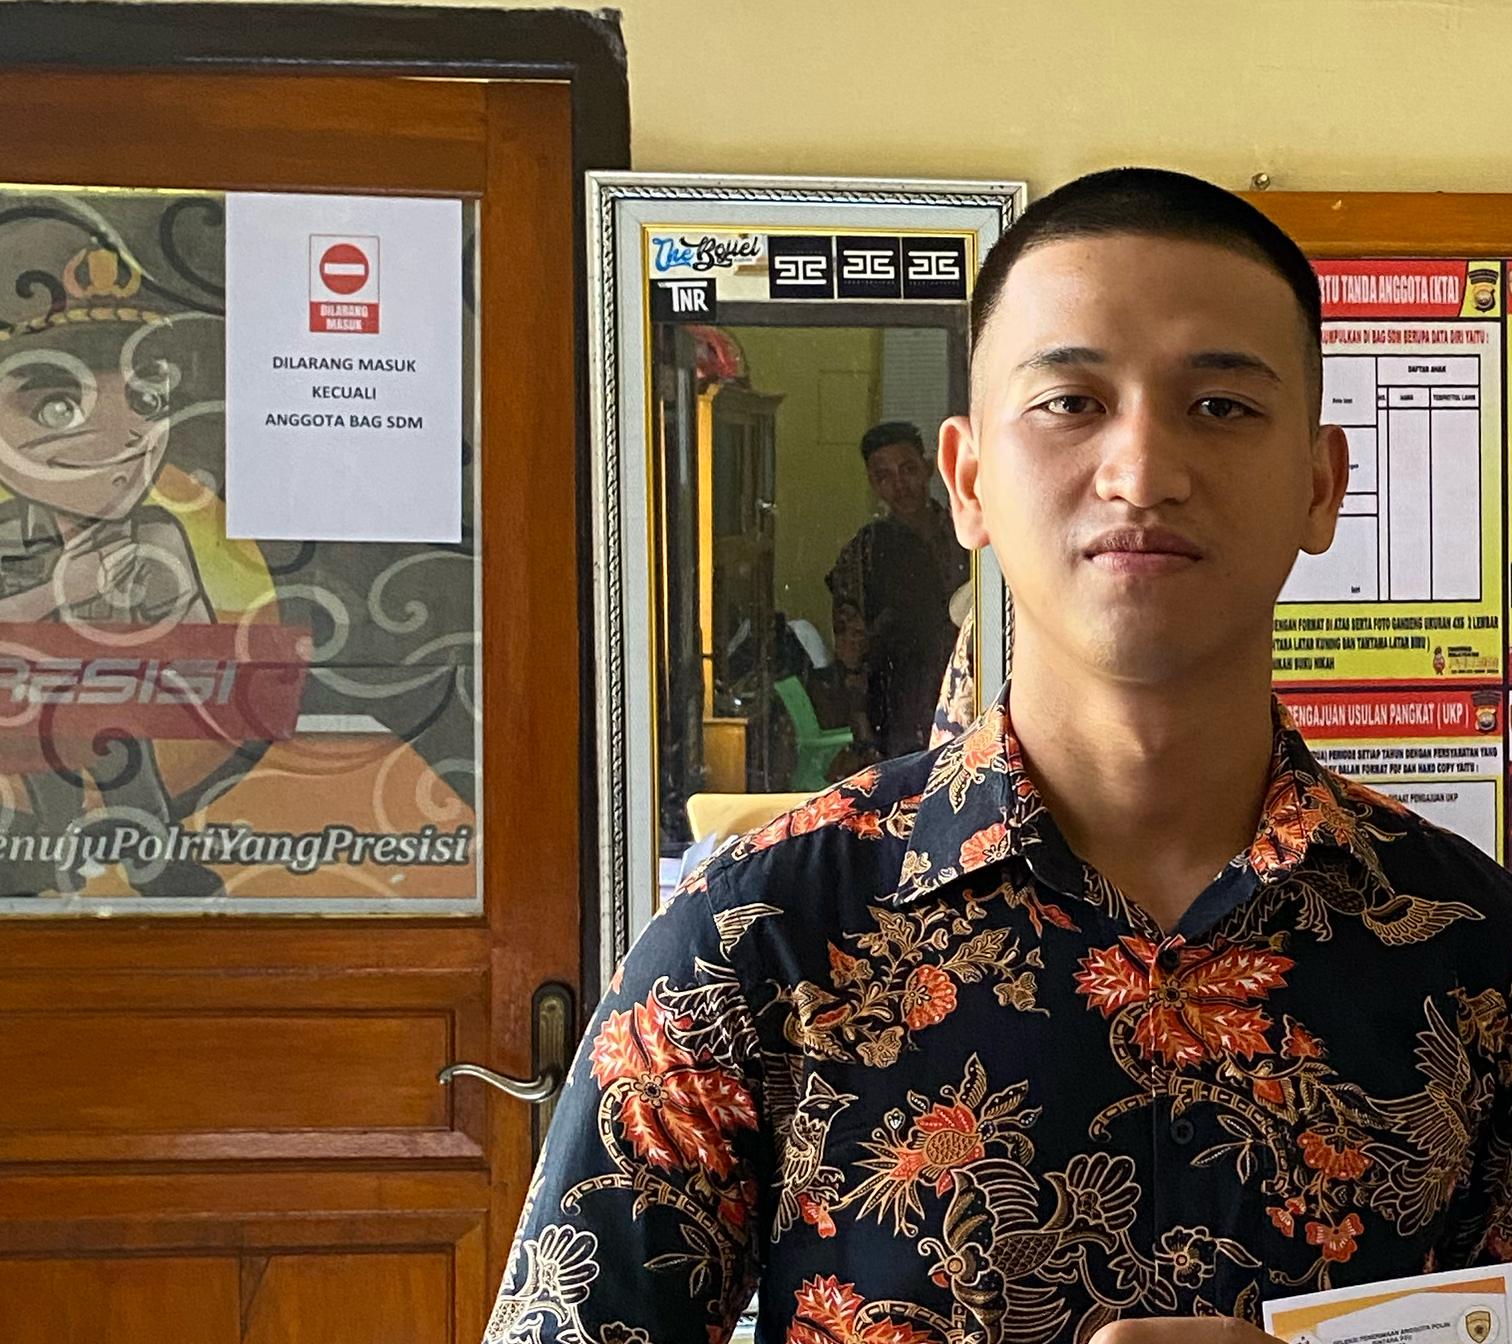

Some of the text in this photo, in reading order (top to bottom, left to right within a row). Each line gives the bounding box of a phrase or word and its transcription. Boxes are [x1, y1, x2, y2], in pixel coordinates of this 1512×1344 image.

[658, 281, 709, 312] TNR
[1342, 276, 1377, 304] TANDA
[1378, 275, 1429, 304] ANGGOTA
[326, 317, 362, 330] MASUK
[273, 357, 417, 373] DILARANG MASUK
[312, 386, 376, 400] KECUALI
[265, 414, 423, 430] ANGGOTA BAG SDM
[1348, 704, 1389, 726] USULAN
[1390, 703, 1434, 725] PANGKAT
[1443, 703, 1463, 724] UKP
